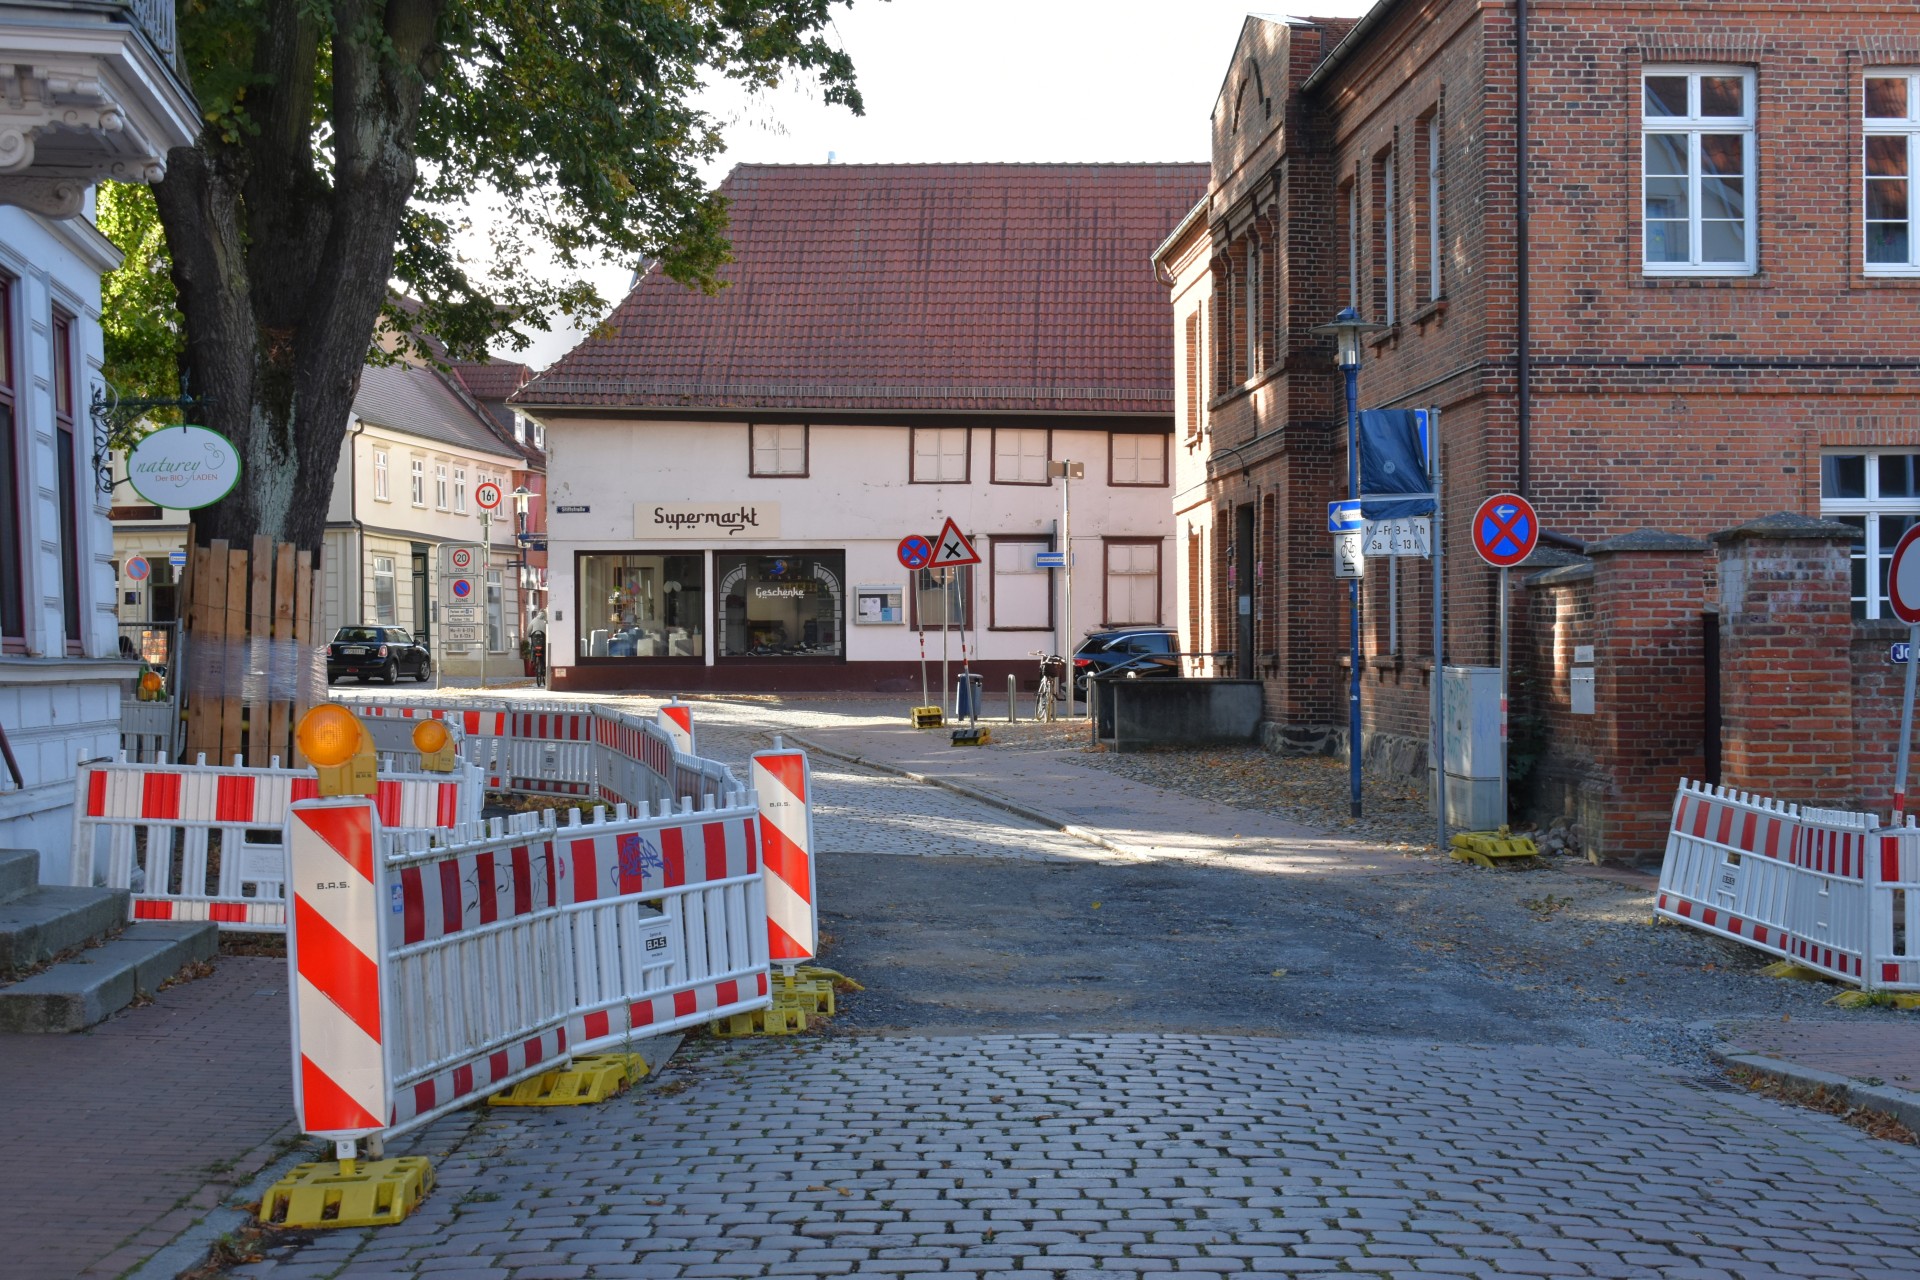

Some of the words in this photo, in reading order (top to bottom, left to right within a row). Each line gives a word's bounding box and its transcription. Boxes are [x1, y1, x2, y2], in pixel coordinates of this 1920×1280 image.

[136, 456, 200, 487] naturey
[155, 474, 168, 482] Der
[653, 506, 760, 536] Supermarkt
[1371, 540, 1382, 550] Sa
[456, 553, 467, 563] 20
[755, 586, 805, 599] Geschenke
[316, 881, 350, 890] B.A.S.
